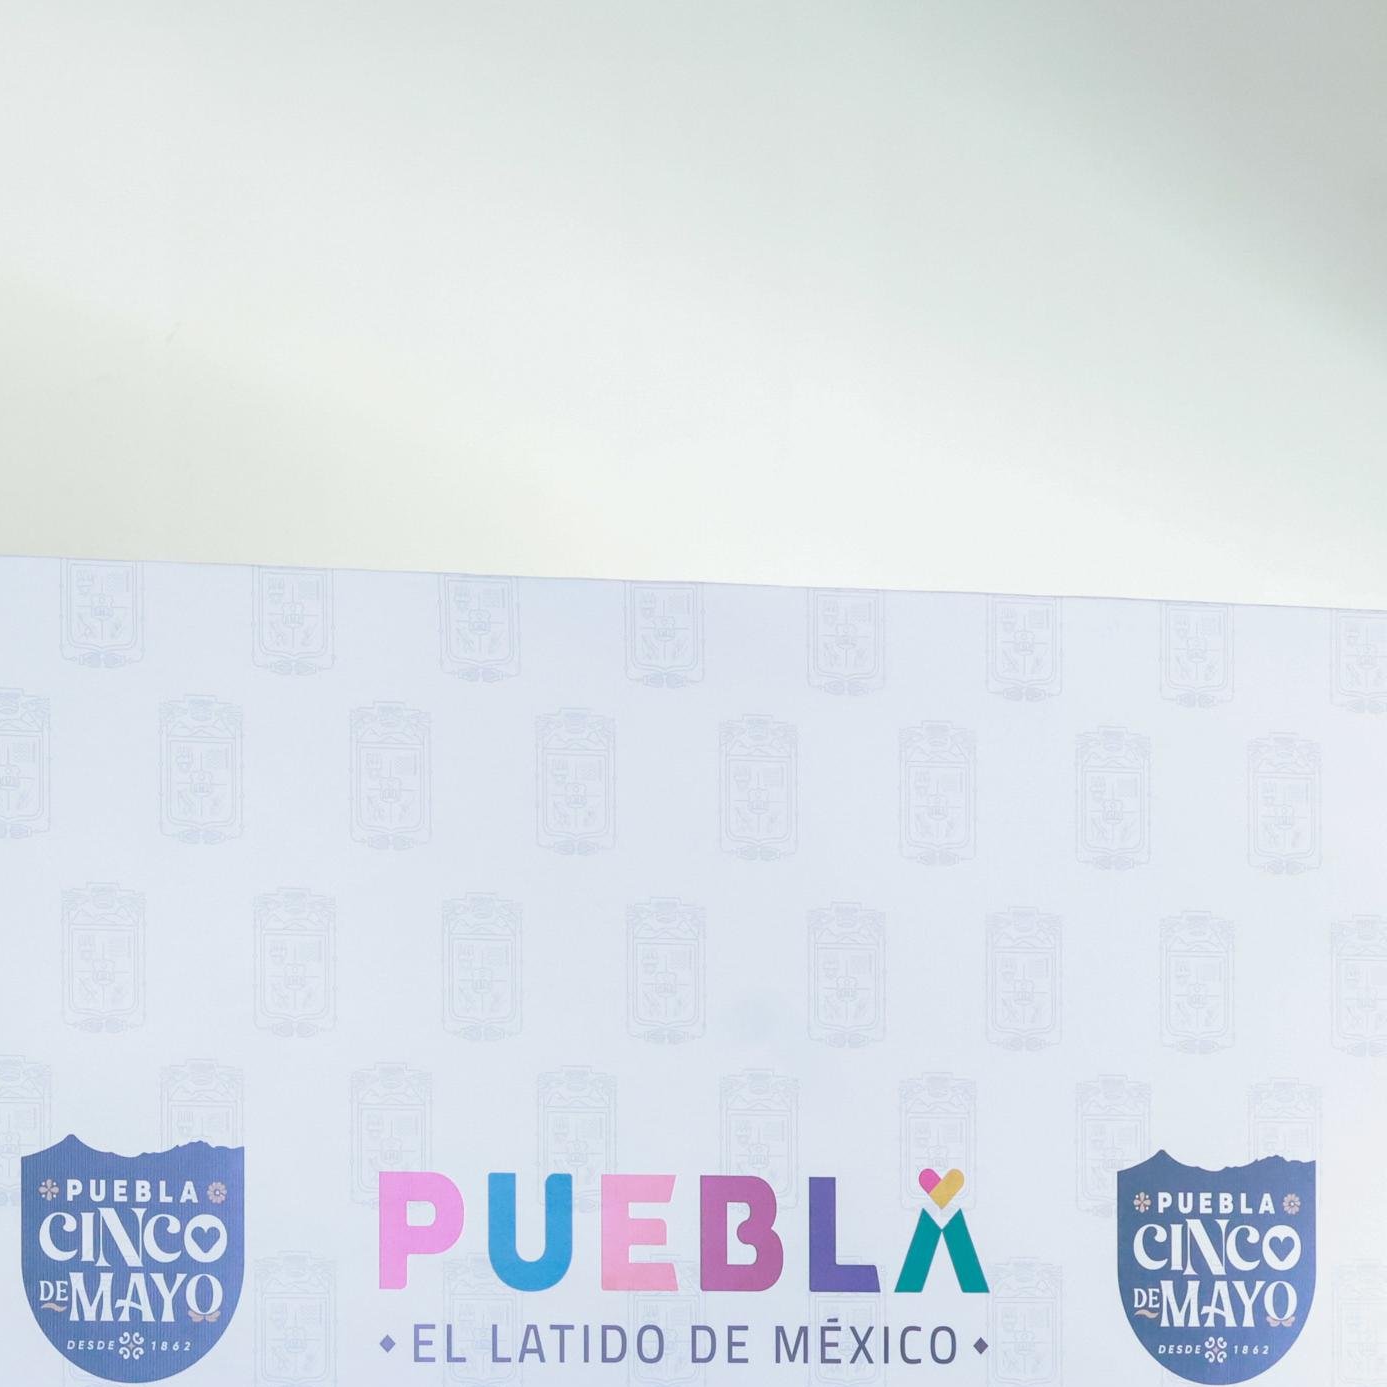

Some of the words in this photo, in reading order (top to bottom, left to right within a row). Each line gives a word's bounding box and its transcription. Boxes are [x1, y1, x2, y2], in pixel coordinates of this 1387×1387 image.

[67, 1179, 199, 1203] PUEBLA
[1157, 1191, 1275, 1214] PUEBLA
[38, 1207, 227, 1267] CINCO
[379, 1168, 990, 1293] PUEBLA
[1133, 1218, 1302, 1275] CINCO
[39, 1280, 68, 1302] DE
[69, 1272, 223, 1322] MAYO
[1133, 1288, 1160, 1308] DE
[1160, 1280, 1297, 1328] MAYO
[67, 1339, 115, 1351] DESDE
[151, 1339, 192, 1351] 1862
[413, 1324, 467, 1363] EL
[492, 1324, 665, 1364] LATIDO
[691, 1325, 749, 1364] DE
[775, 1318, 958, 1365] MÉXICO
[1158, 1344, 1202, 1354] DESDE
[1233, 1344, 1269, 1355] 1862
